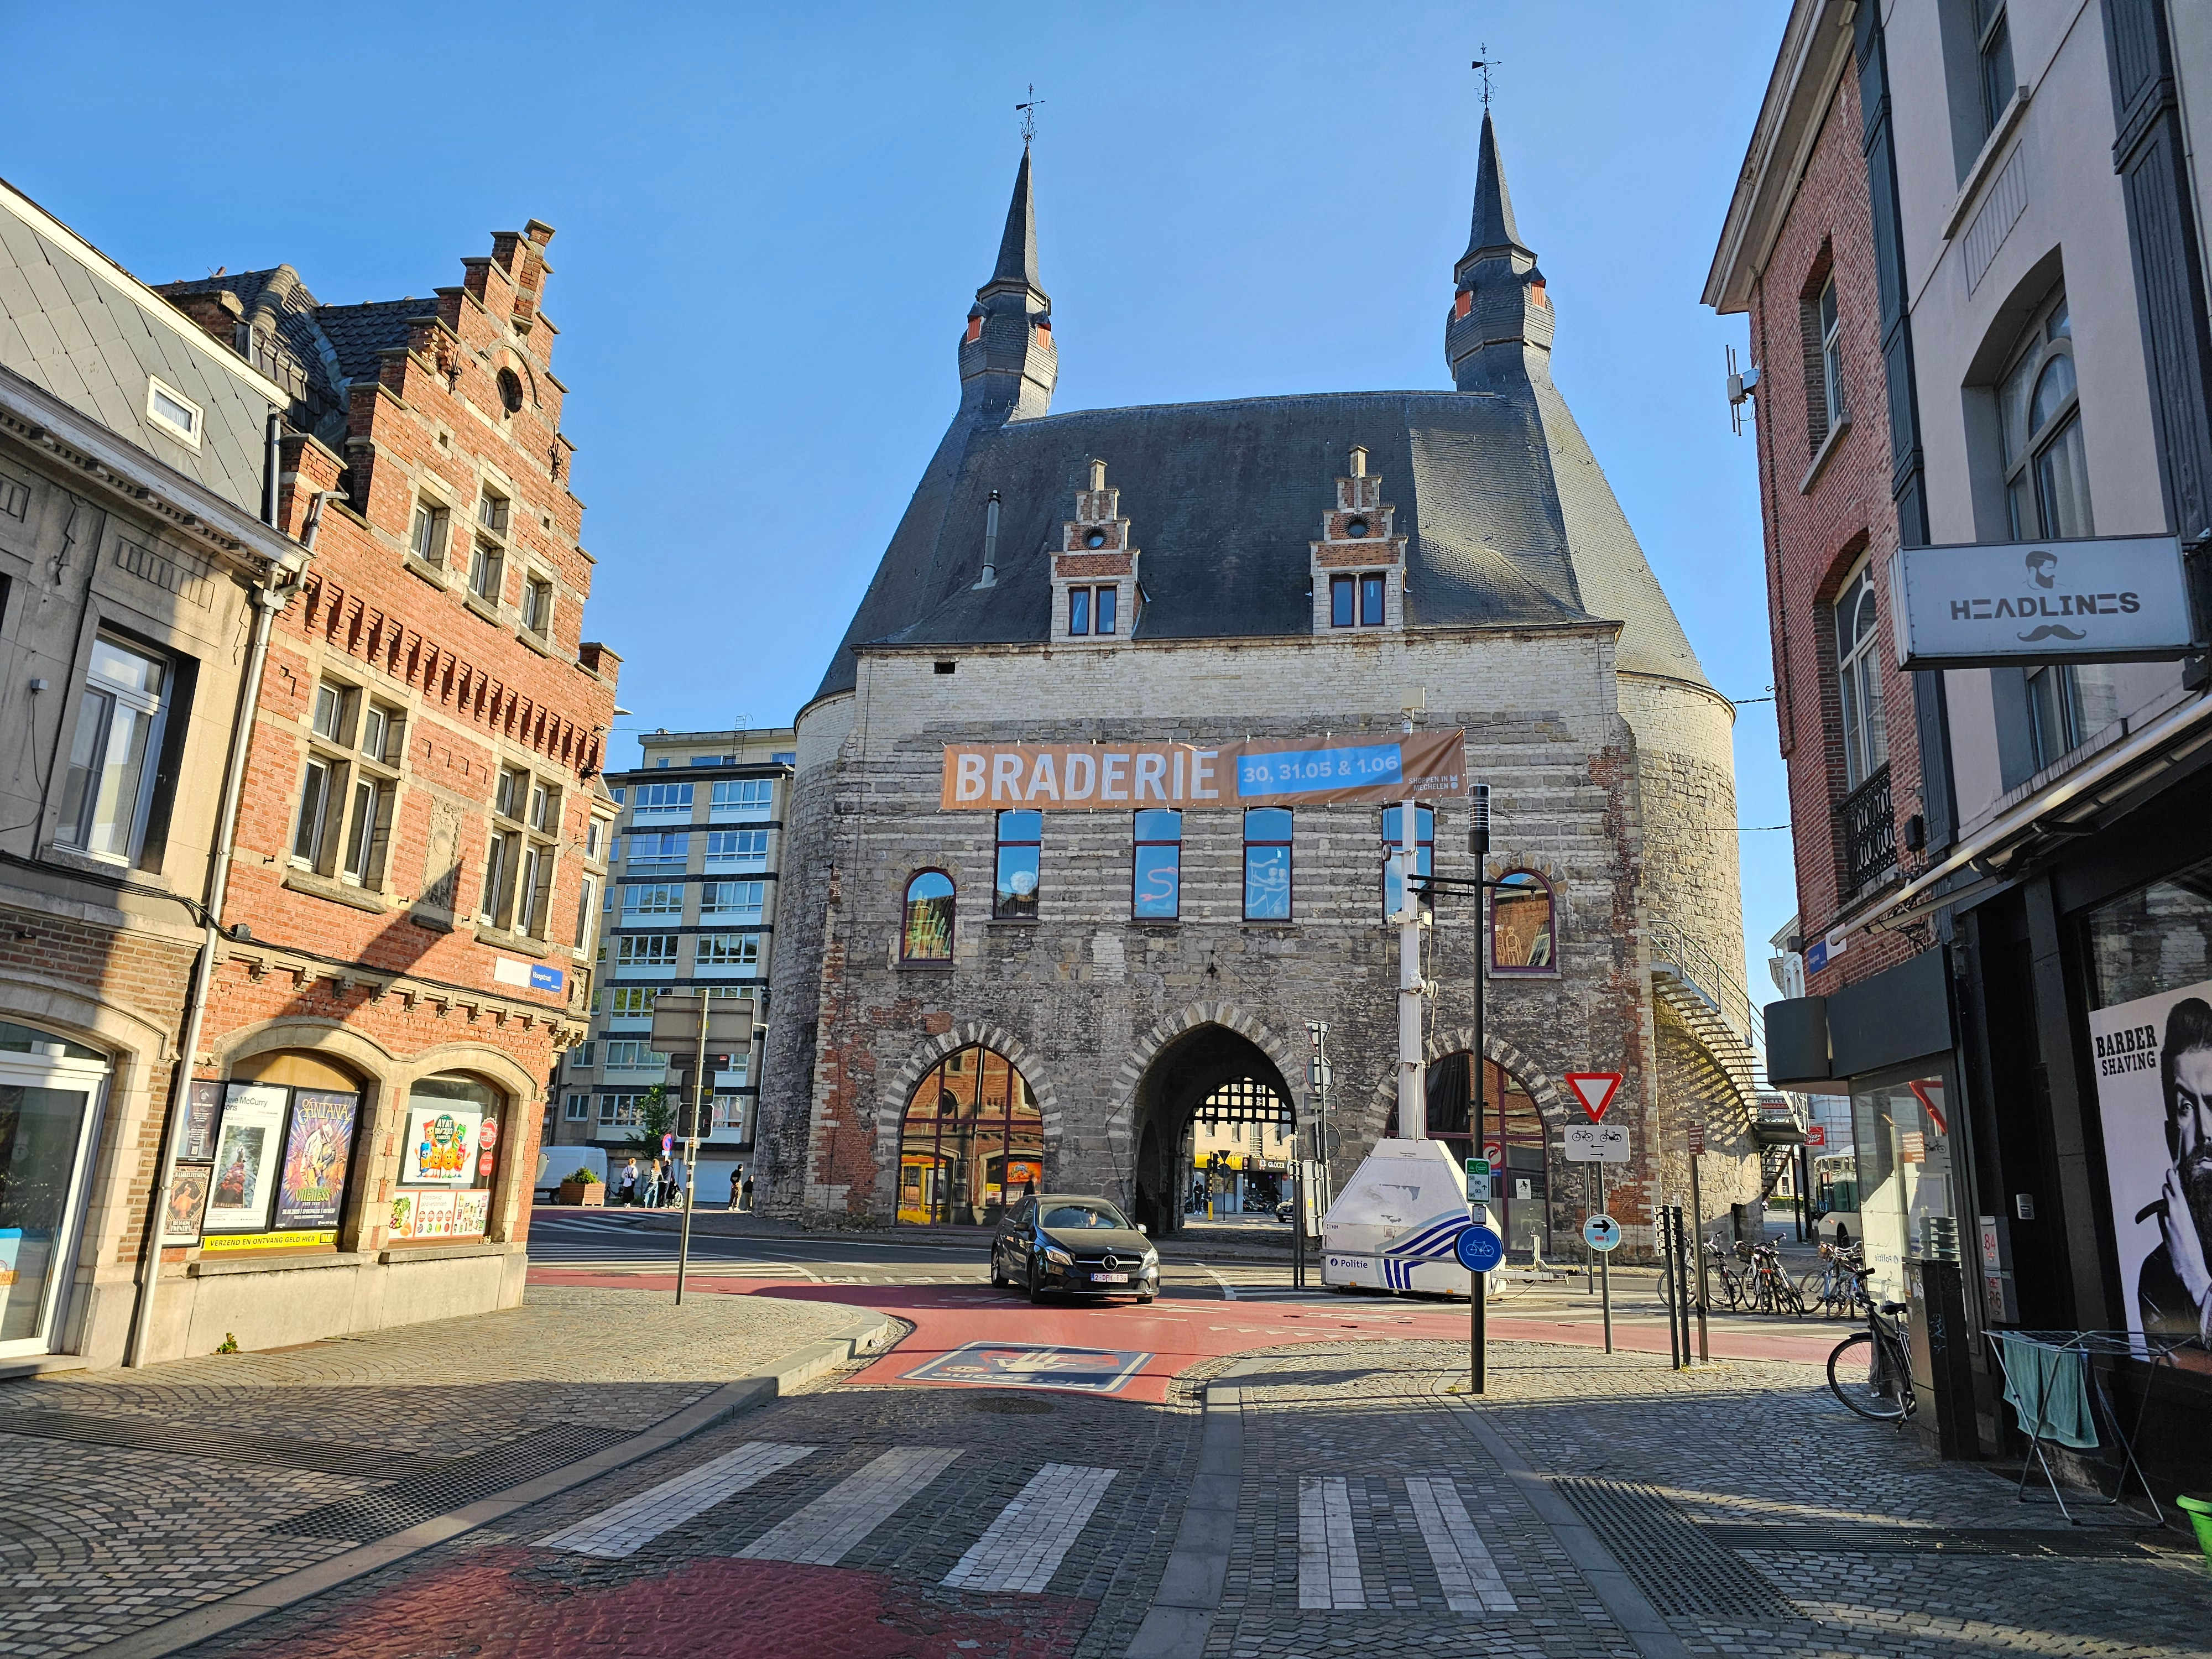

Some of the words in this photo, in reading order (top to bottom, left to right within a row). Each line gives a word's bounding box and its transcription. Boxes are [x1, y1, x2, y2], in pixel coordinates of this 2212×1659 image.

[1950, 592, 2140, 620] HEADLINES
[956, 751, 1219, 801] BRADERIE
[1243, 766, 1274, 783] 30,
[1279, 762, 1331, 780] 31.05
[1338, 761, 1353, 775] &
[1357, 756, 1399, 774] 1.06
[1408, 776, 1439, 784] SHOPPEN
[1413, 782, 1449, 791] MECHELEN
[2095, 1025, 2158, 1058] BARBER
[2102, 1051, 2156, 1076] SHAVING
[239, 1097, 268, 1108] McCurry
[298, 1098, 353, 1124] SANTANA
[1984, 1234, 1996, 1250] 84
[1341, 1259, 1368, 1269] Politie
